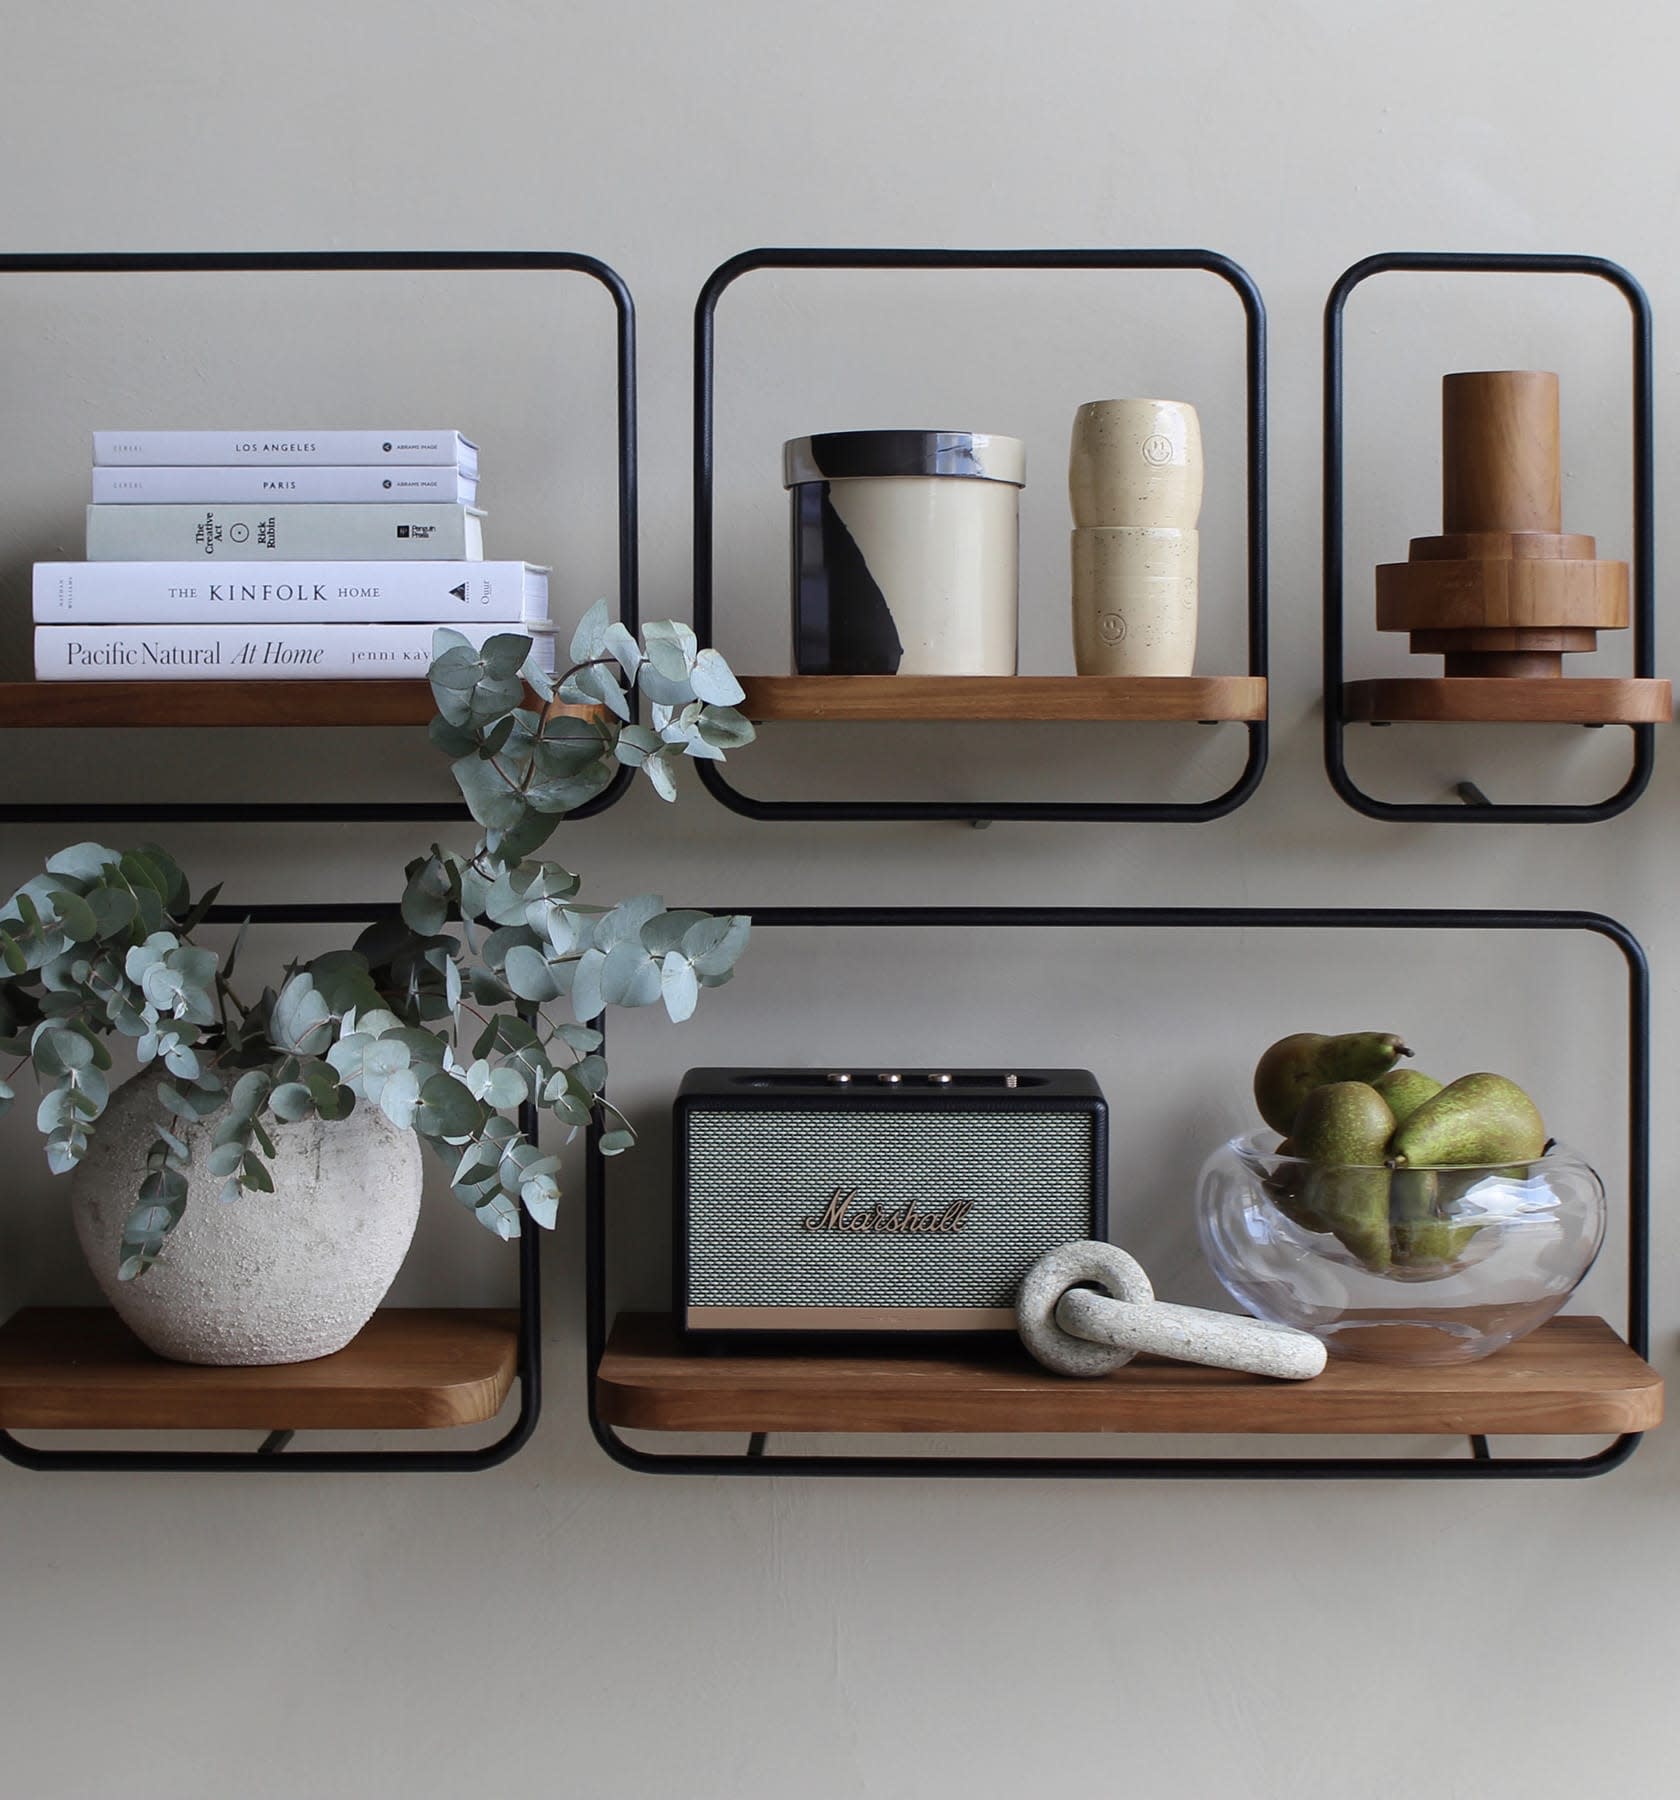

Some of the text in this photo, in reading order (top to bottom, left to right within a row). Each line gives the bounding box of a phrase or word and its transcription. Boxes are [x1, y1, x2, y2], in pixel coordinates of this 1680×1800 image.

[236, 443, 316, 452] LOS ANGELES
[263, 481, 296, 489] PARIS
[196, 523, 204, 544] The
[205, 512, 214, 554] Creative
[214, 525, 223, 543] Act
[258, 521, 266, 544] Rick
[267, 517, 275, 549] Rubin
[168, 585, 380, 600] THE KINFOLK HOME
[67, 641, 324, 665] Pacific Natural At Home
[805, 1188, 974, 1233] Marshall
